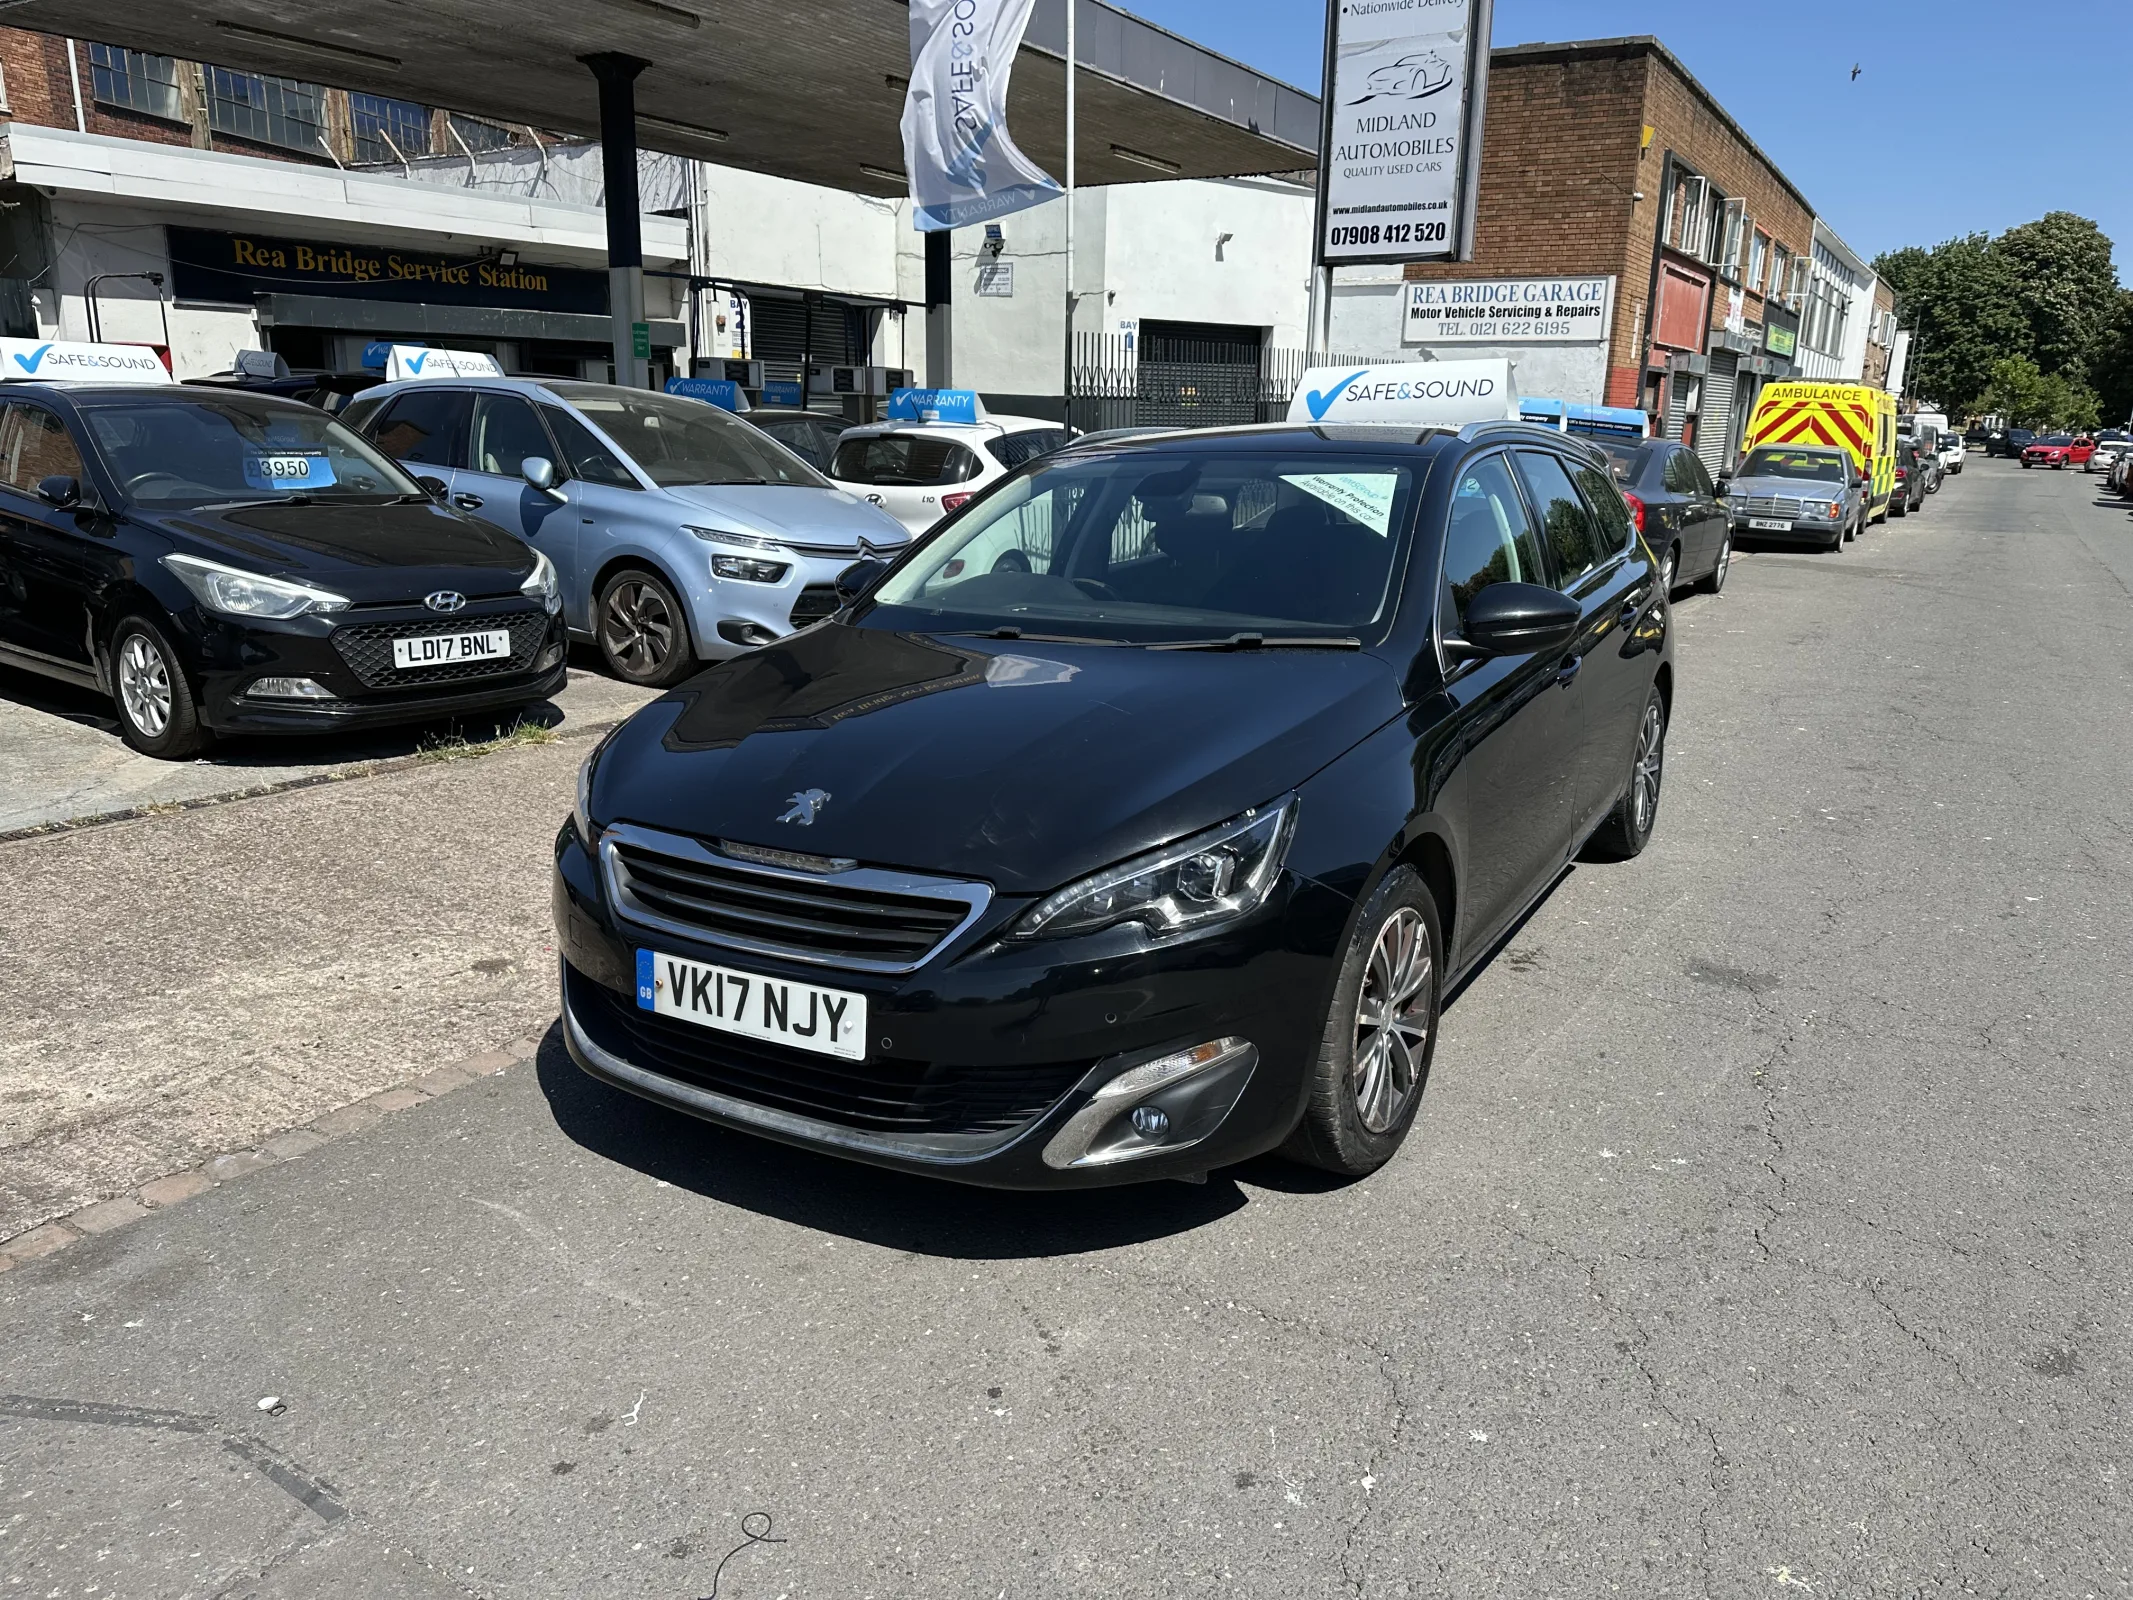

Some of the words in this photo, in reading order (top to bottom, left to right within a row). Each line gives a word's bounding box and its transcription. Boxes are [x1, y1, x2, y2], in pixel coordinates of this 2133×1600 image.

[1350, 0, 1413, 16] Nationwide
[1356, 111, 1436, 134] MIDLAND
[1335, 137, 1454, 161] AUTOMOBILES
[1343, 165, 1384, 178] QUALITY
[1387, 163, 1413, 175] USED
[1416, 161, 1442, 172] CARS
[1332, 200, 1448, 215] www.midlandautomobiles.co.uk
[1331, 225, 1380, 245] 07908
[1383, 223, 1411, 243] 412
[1414, 221, 1446, 241] 520
[232, 238, 286, 269] Rea
[296, 245, 381, 281] Bridge
[388, 254, 470, 285] Service
[478, 264, 548, 292] Station
[1412, 286, 1447, 304] REA
[1452, 284, 1520, 303] BRIDGE
[1523, 282, 1602, 302] GARAGE
[1411, 306, 1442, 319] Motor
[1444, 305, 1486, 318] Vehicle
[1488, 305, 1541, 319] Servicing
[1545, 306, 1553, 317] &
[1556, 304, 1600, 318] Repairs
[1120, 321, 1137, 329] BAY
[1438, 322, 1466, 336] TEL.
[1470, 322, 1498, 336] 0121
[1501, 321, 1531, 335] 622
[1534, 321, 1570, 335] 6195
[46, 352, 156, 370] SAFE&SOUND
[682, 382, 731, 396] WARRANTY
[1346, 378, 1494, 401] SAFE&SOUND
[1771, 388, 1862, 401] AMBULANCE
[911, 393, 970, 408] WARRANTY
[1312, 475, 1346, 494] Warranty
[1346, 492, 1385, 517] Protection
[1334, 498, 1346, 506] on
[1345, 502, 1361, 514] this
[408, 637, 454, 662] LD17
[460, 634, 497, 656] BNL
[639, 985, 652, 1000] GB
[667, 961, 750, 1022] VK17
[763, 982, 848, 1043] NJY
